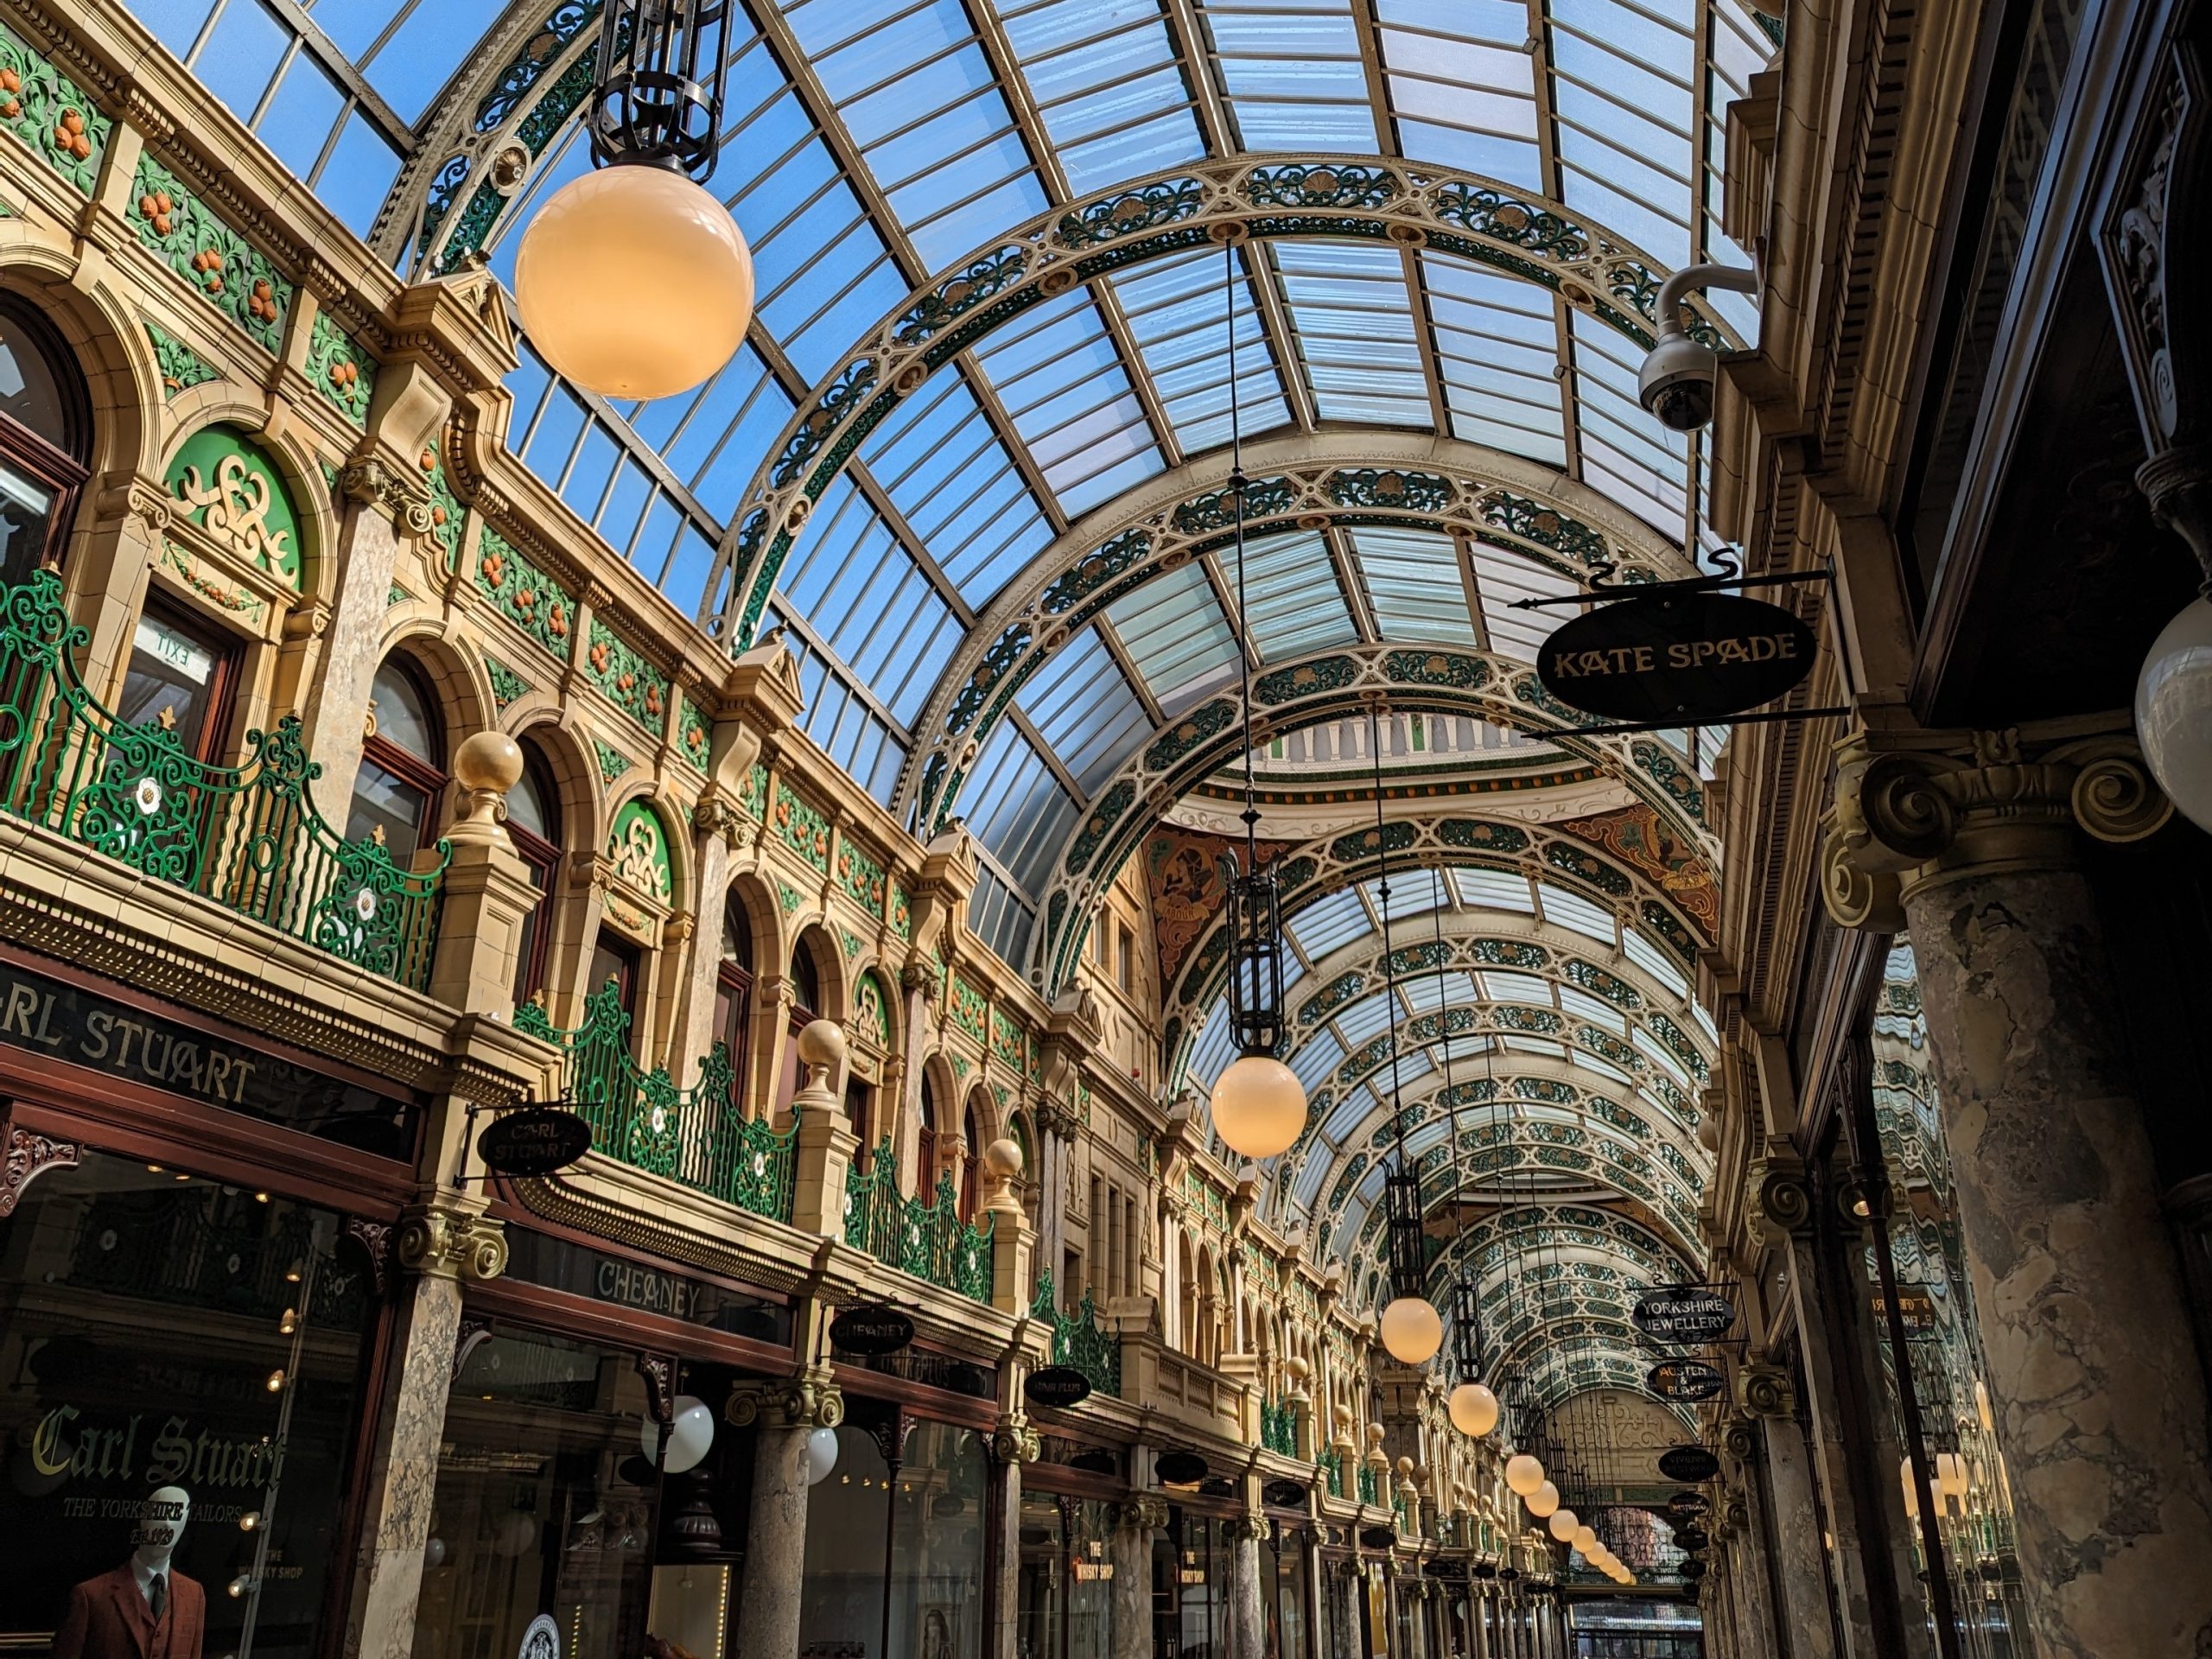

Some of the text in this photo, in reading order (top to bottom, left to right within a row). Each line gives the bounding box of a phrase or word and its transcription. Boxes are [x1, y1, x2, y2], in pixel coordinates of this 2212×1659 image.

[1554, 632, 1799, 678] KATE SPADE
[0, 982, 256, 1104] RL STUART
[511, 1123, 560, 1140] CARL
[598, 1262, 701, 1318] CHEANEY
[1642, 1300, 1725, 1315] YORKSHIRE
[836, 1324, 908, 1338] CHEANEY
[1644, 1316, 1726, 1331] JEWELLERY
[1659, 1366, 1707, 1376] AUSTEN
[1681, 1376, 1688, 1385] &
[1667, 1384, 1706, 1395] BLAKE
[32, 1404, 288, 1489] Carl Stuart
[63, 1497, 242, 1522] THE YORKSHIRE TAILORS
[1090, 1541, 1102, 1557] THE
[1077, 1564, 1114, 1580] WHISKY SHOP
